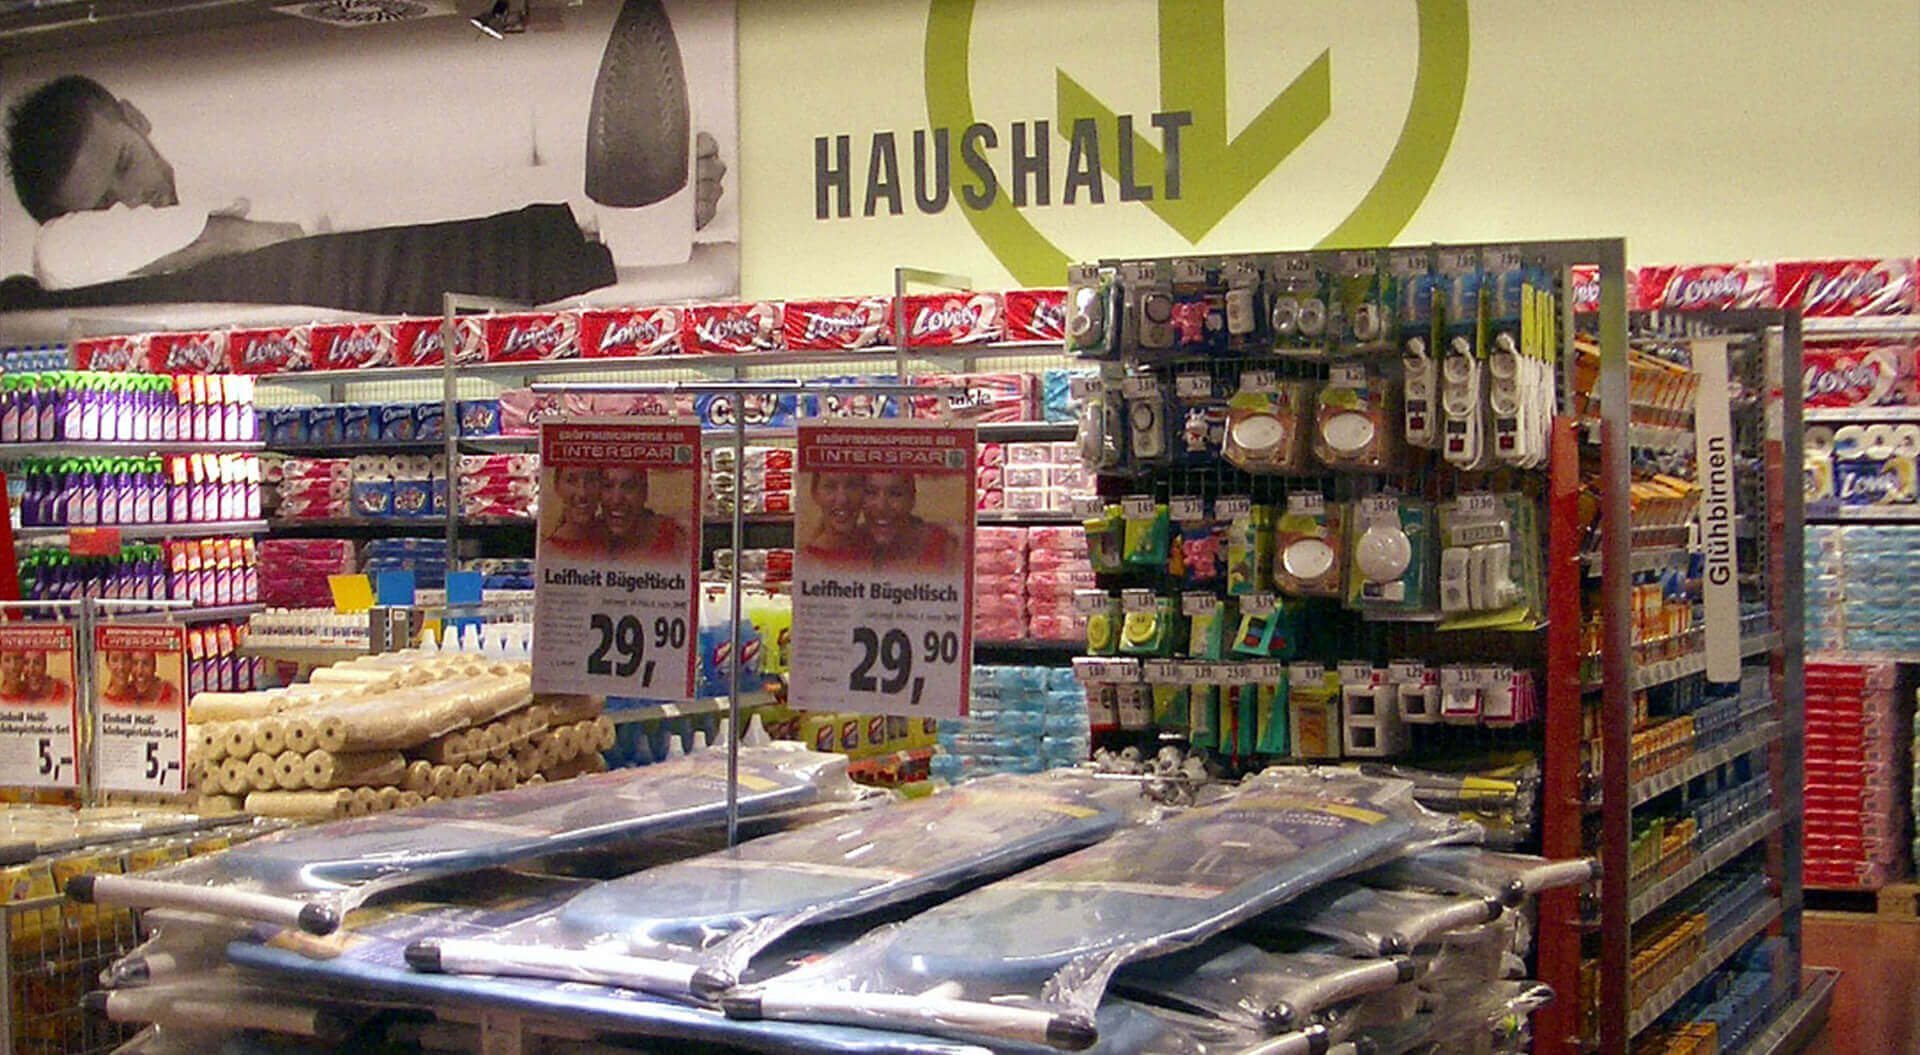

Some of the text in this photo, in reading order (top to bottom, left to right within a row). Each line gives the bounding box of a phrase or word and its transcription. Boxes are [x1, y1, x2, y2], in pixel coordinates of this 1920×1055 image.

[815, 111, 1192, 219] HAUSHALT
[1667, 275, 1743, 306] Lovely
[600, 321, 659, 349] Lovely
[911, 306, 977, 337] Lovely
[563, 445, 673, 458] INTERSPAR
[820, 449, 945, 463] INTERSPAR
[1707, 435, 1731, 586] Glühbirnen
[545, 568, 685, 592] Leifheit Bügeltisch
[801, 580, 959, 605] Leifheit Bügeltisch
